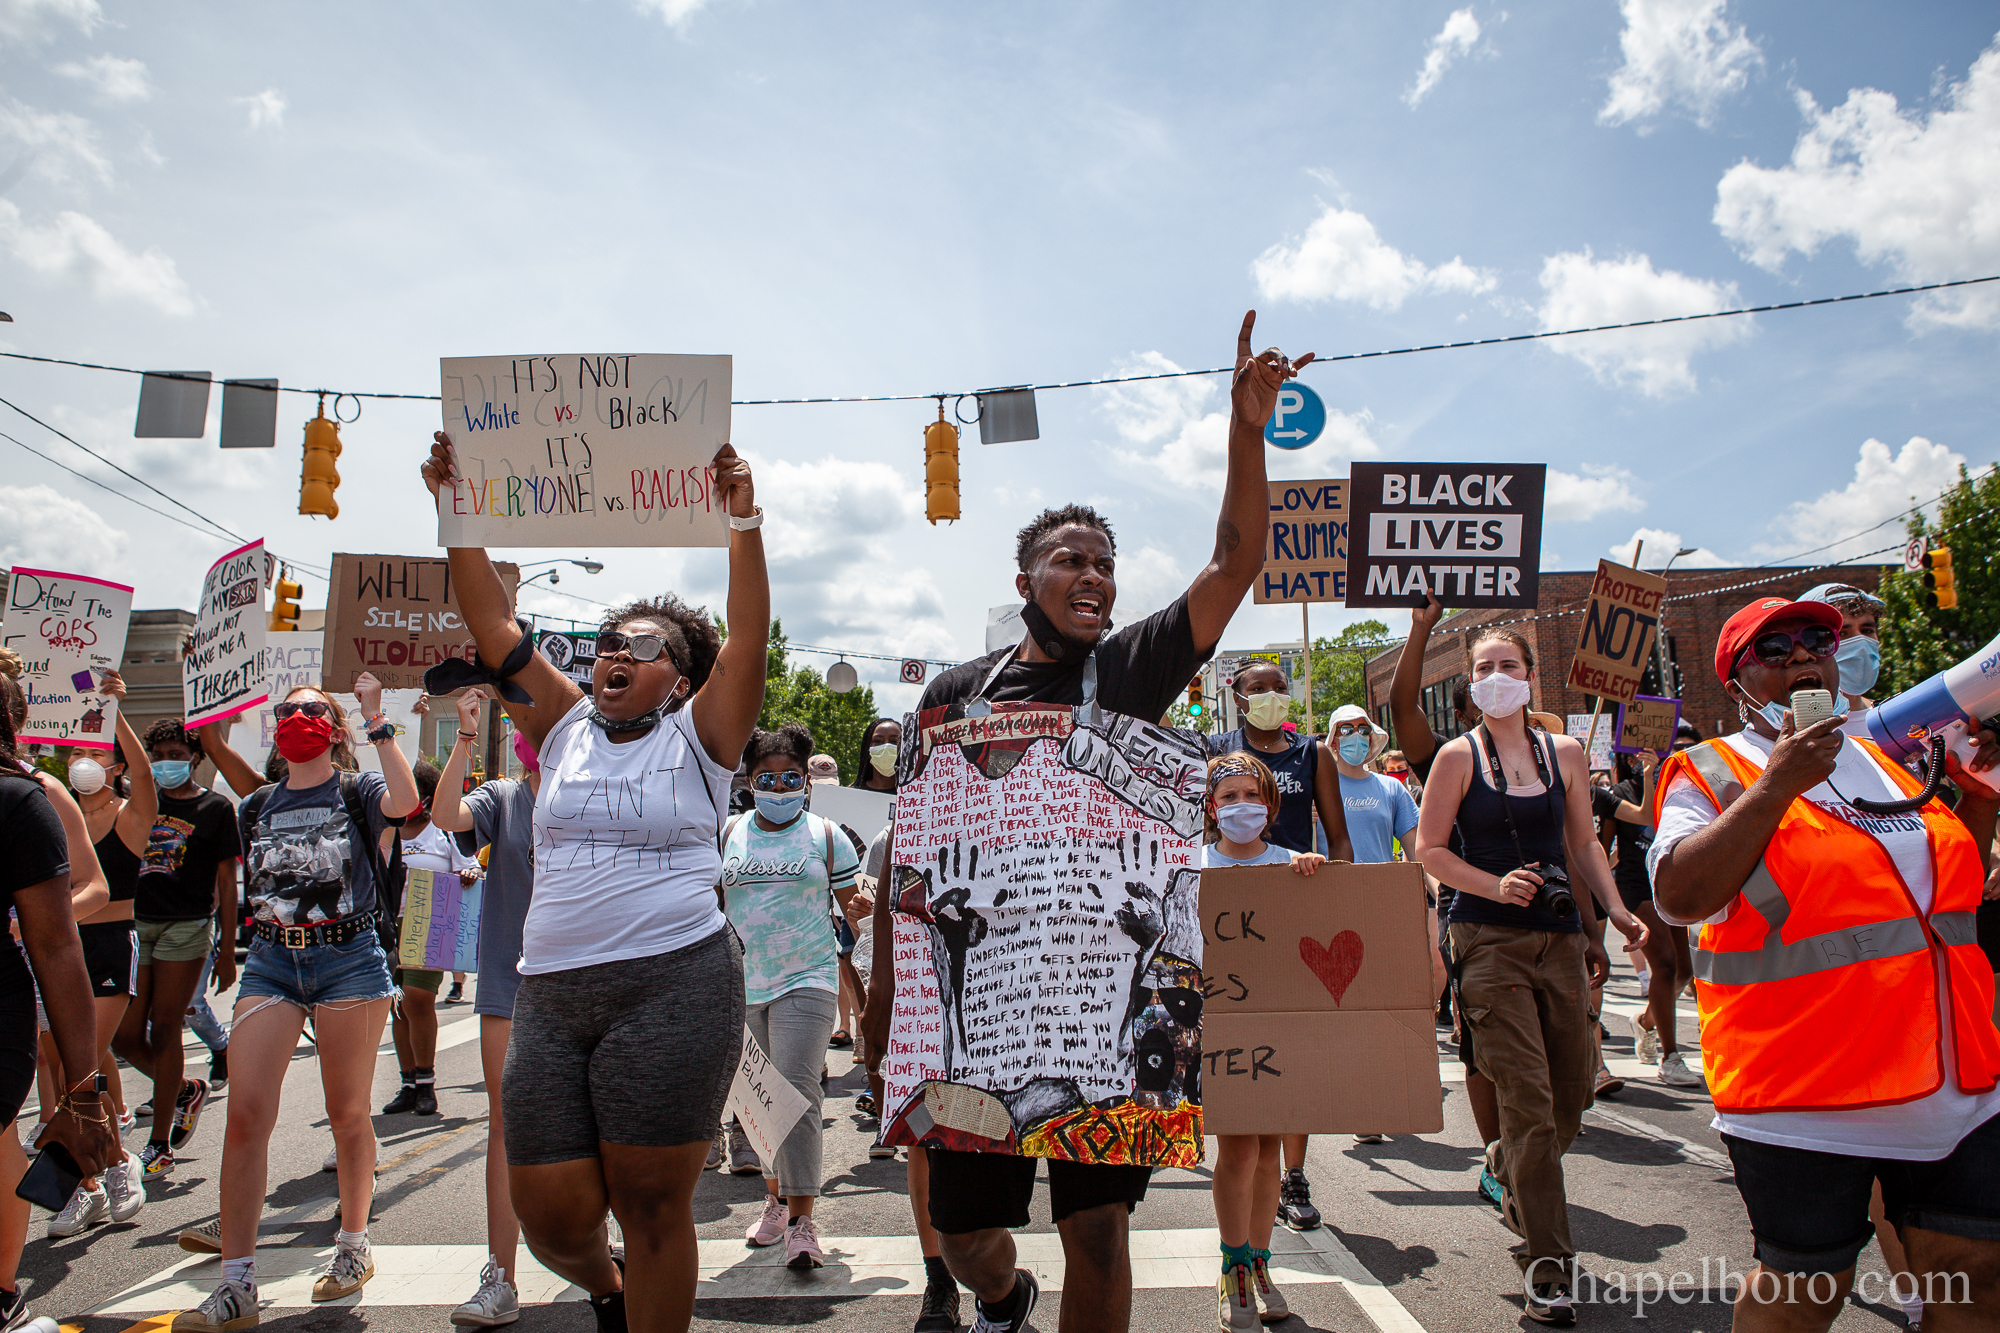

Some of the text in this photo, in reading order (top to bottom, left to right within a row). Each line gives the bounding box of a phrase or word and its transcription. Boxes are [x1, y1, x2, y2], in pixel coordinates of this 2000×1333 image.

[511, 354, 638, 394] IT'S NOT
[464, 396, 678, 432] White vs. Black
[1274, 389, 1304, 428] P
[546, 432, 594, 470] IT'S
[452, 472, 595, 518] EVERYONE
[603, 495, 630, 513] vs.
[1269, 485, 1343, 512] LOVE
[1382, 474, 1515, 506] BLACK
[1386, 520, 1504, 551] LIVES
[204, 555, 257, 595] HE COLOR
[357, 560, 450, 604] WHIT
[1264, 571, 1346, 599] HATE
[1365, 565, 1521, 597] MATTER
[1592, 563, 1664, 613] PROTECT
[12, 573, 113, 619] Defund The
[212, 588, 230, 615] MY
[230, 580, 257, 610] SKIN
[40, 617, 98, 646] COPS
[222, 611, 243, 632] NOT
[363, 606, 469, 633] SILENC
[1580, 598, 1658, 668] NOT
[187, 631, 247, 675] MAKE ME A
[17, 677, 72, 705] ducation
[351, 670, 424, 687] DUND THE
[1569, 658, 1641, 701] NEGLECT
[1628, 701, 1644, 714] NO
[1636, 714, 1675, 729] JUSTICE
[26, 719, 79, 739] ousing!
[1623, 724, 1640, 737] NO
[1637, 732, 1670, 751] PEACE
[936, 743, 959, 755] LOVE
[1490, 756, 1500, 771] EOS
[1533, 743, 1543, 764] Canon
[549, 766, 685, 822] CAN'T
[1161, 837, 1198, 850] PEACE
[1164, 851, 1192, 866] LOVE
[722, 854, 808, 887] Blessed
[411, 877, 429, 909] Will
[1056, 881, 1083, 895] MEAN
[422, 876, 450, 965] Black Lives
[1201, 911, 1267, 947] CK
[403, 914, 425, 959] When
[1051, 931, 1076, 946] WHO
[1040, 953, 1075, 967] GETS
[1065, 968, 1073, 981] A
[1077, 965, 1115, 980] WORLD
[916, 1019, 941, 1034] PEACE
[967, 1027, 1001, 1046] BLAME
[744, 1035, 771, 1075] NOT
[920, 1038, 941, 1055] LOVE
[741, 1059, 773, 1112] BLACK
